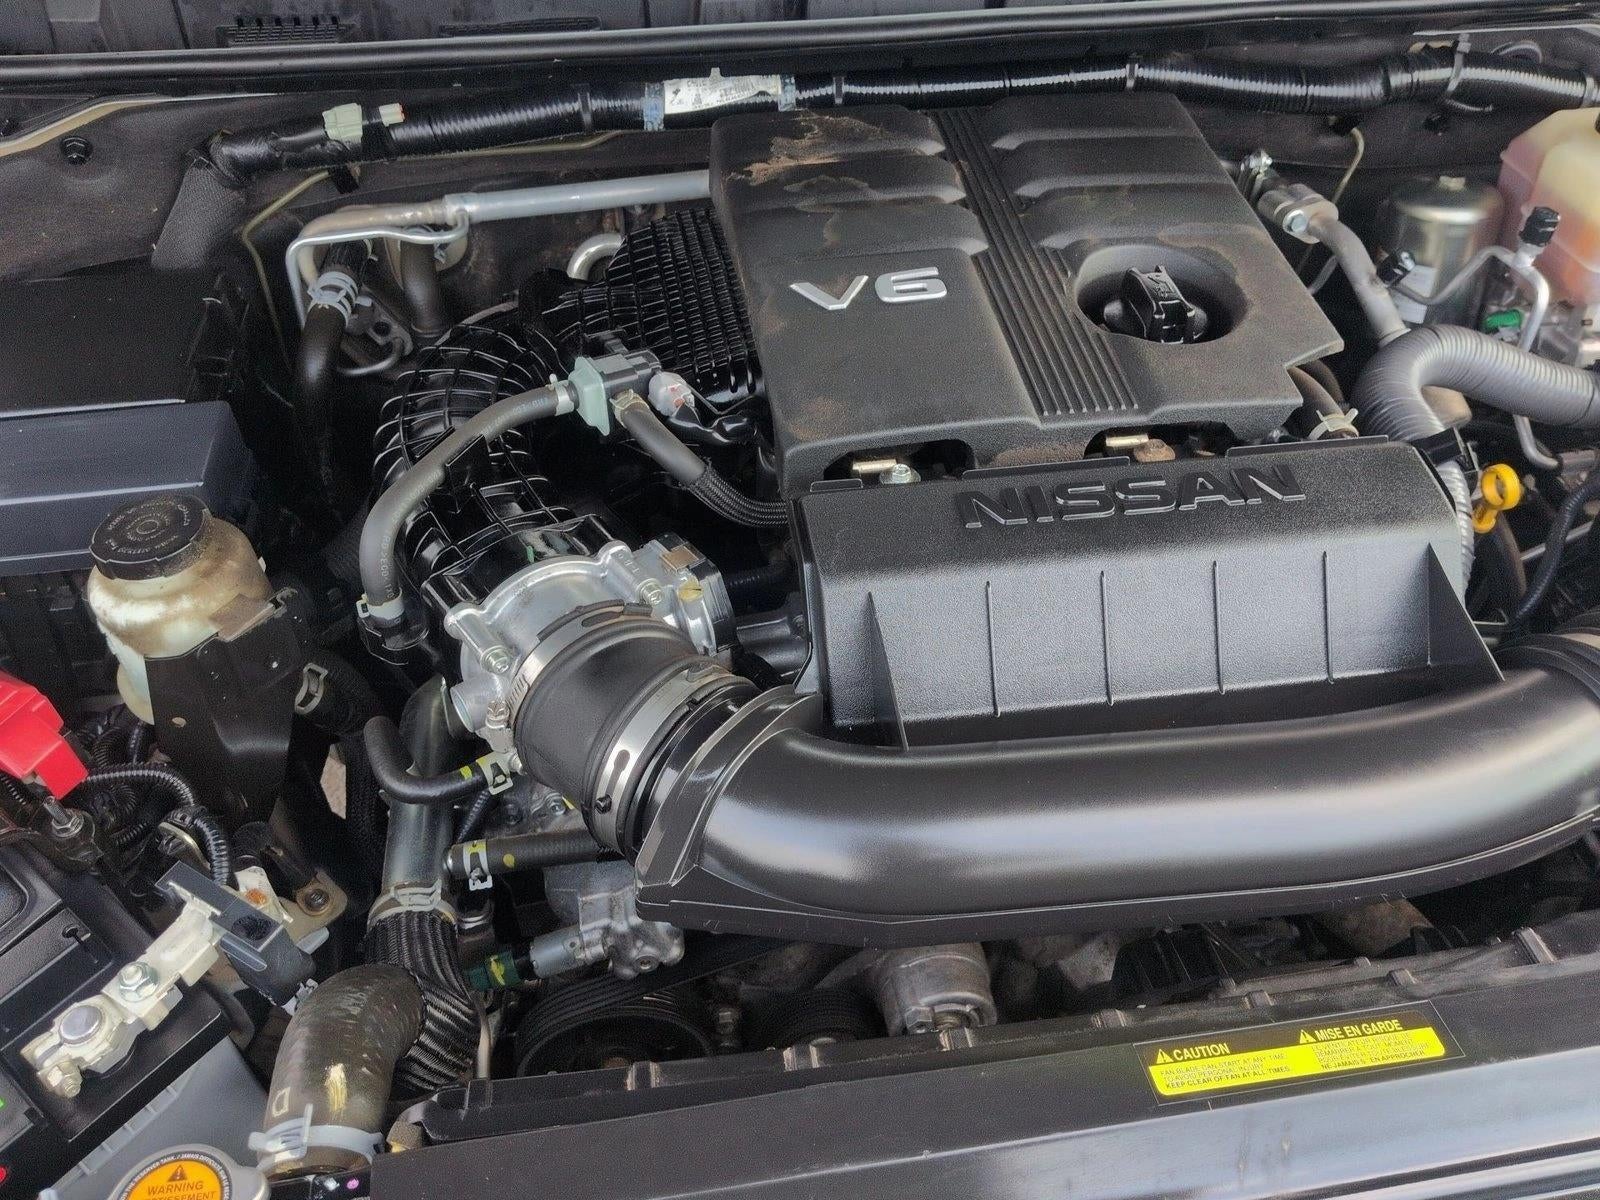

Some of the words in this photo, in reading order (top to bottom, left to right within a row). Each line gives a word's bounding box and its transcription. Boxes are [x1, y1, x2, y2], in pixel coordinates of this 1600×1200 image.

[789, 266, 947, 310] V6
[954, 463, 1306, 528] NISSAN
[1314, 1027, 1345, 1041] MISE
[1343, 1024, 1362, 1037] EN
[1361, 1019, 1403, 1035] GARDE
[1173, 1043, 1230, 1061] CAUTION
[147, 1180, 204, 1196] WARNING
